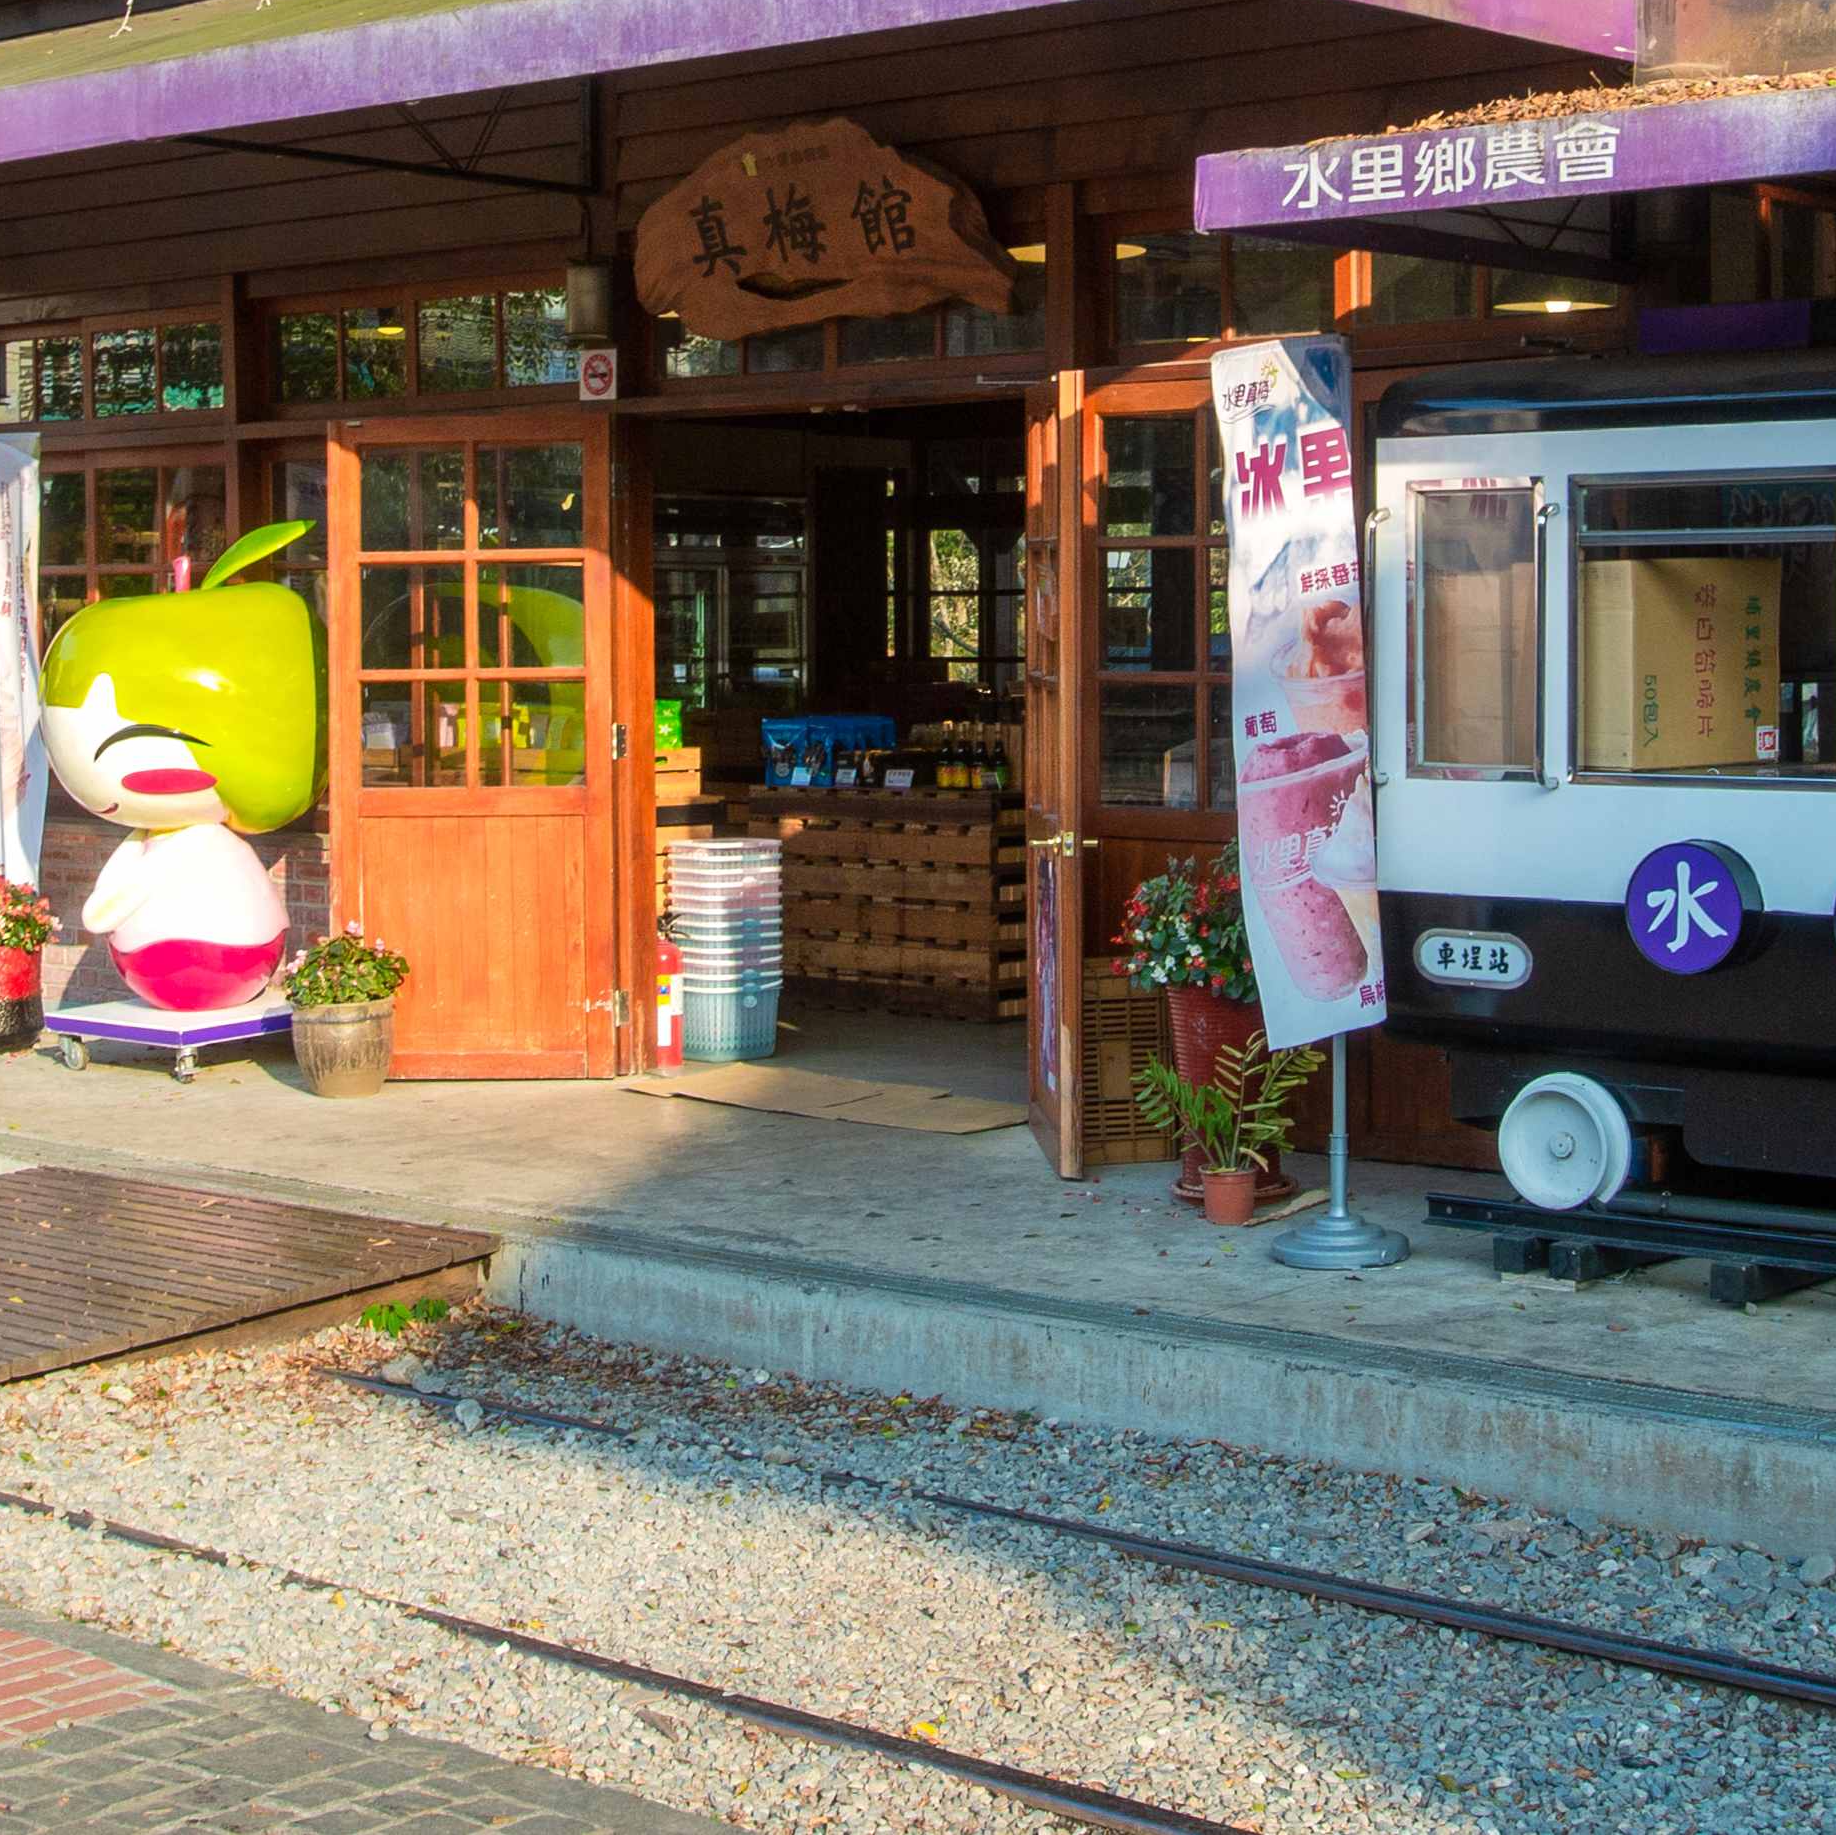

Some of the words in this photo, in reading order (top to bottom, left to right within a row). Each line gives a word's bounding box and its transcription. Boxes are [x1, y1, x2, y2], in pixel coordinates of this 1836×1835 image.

[1282, 121, 1621, 209] 水里鄉農會
[689, 175, 917, 278] 真梅館
[1244, 710, 1278, 740] 葡萄
[1642, 674, 1659, 748] 50包入
[1436, 942, 1510, 974] 車埕站
